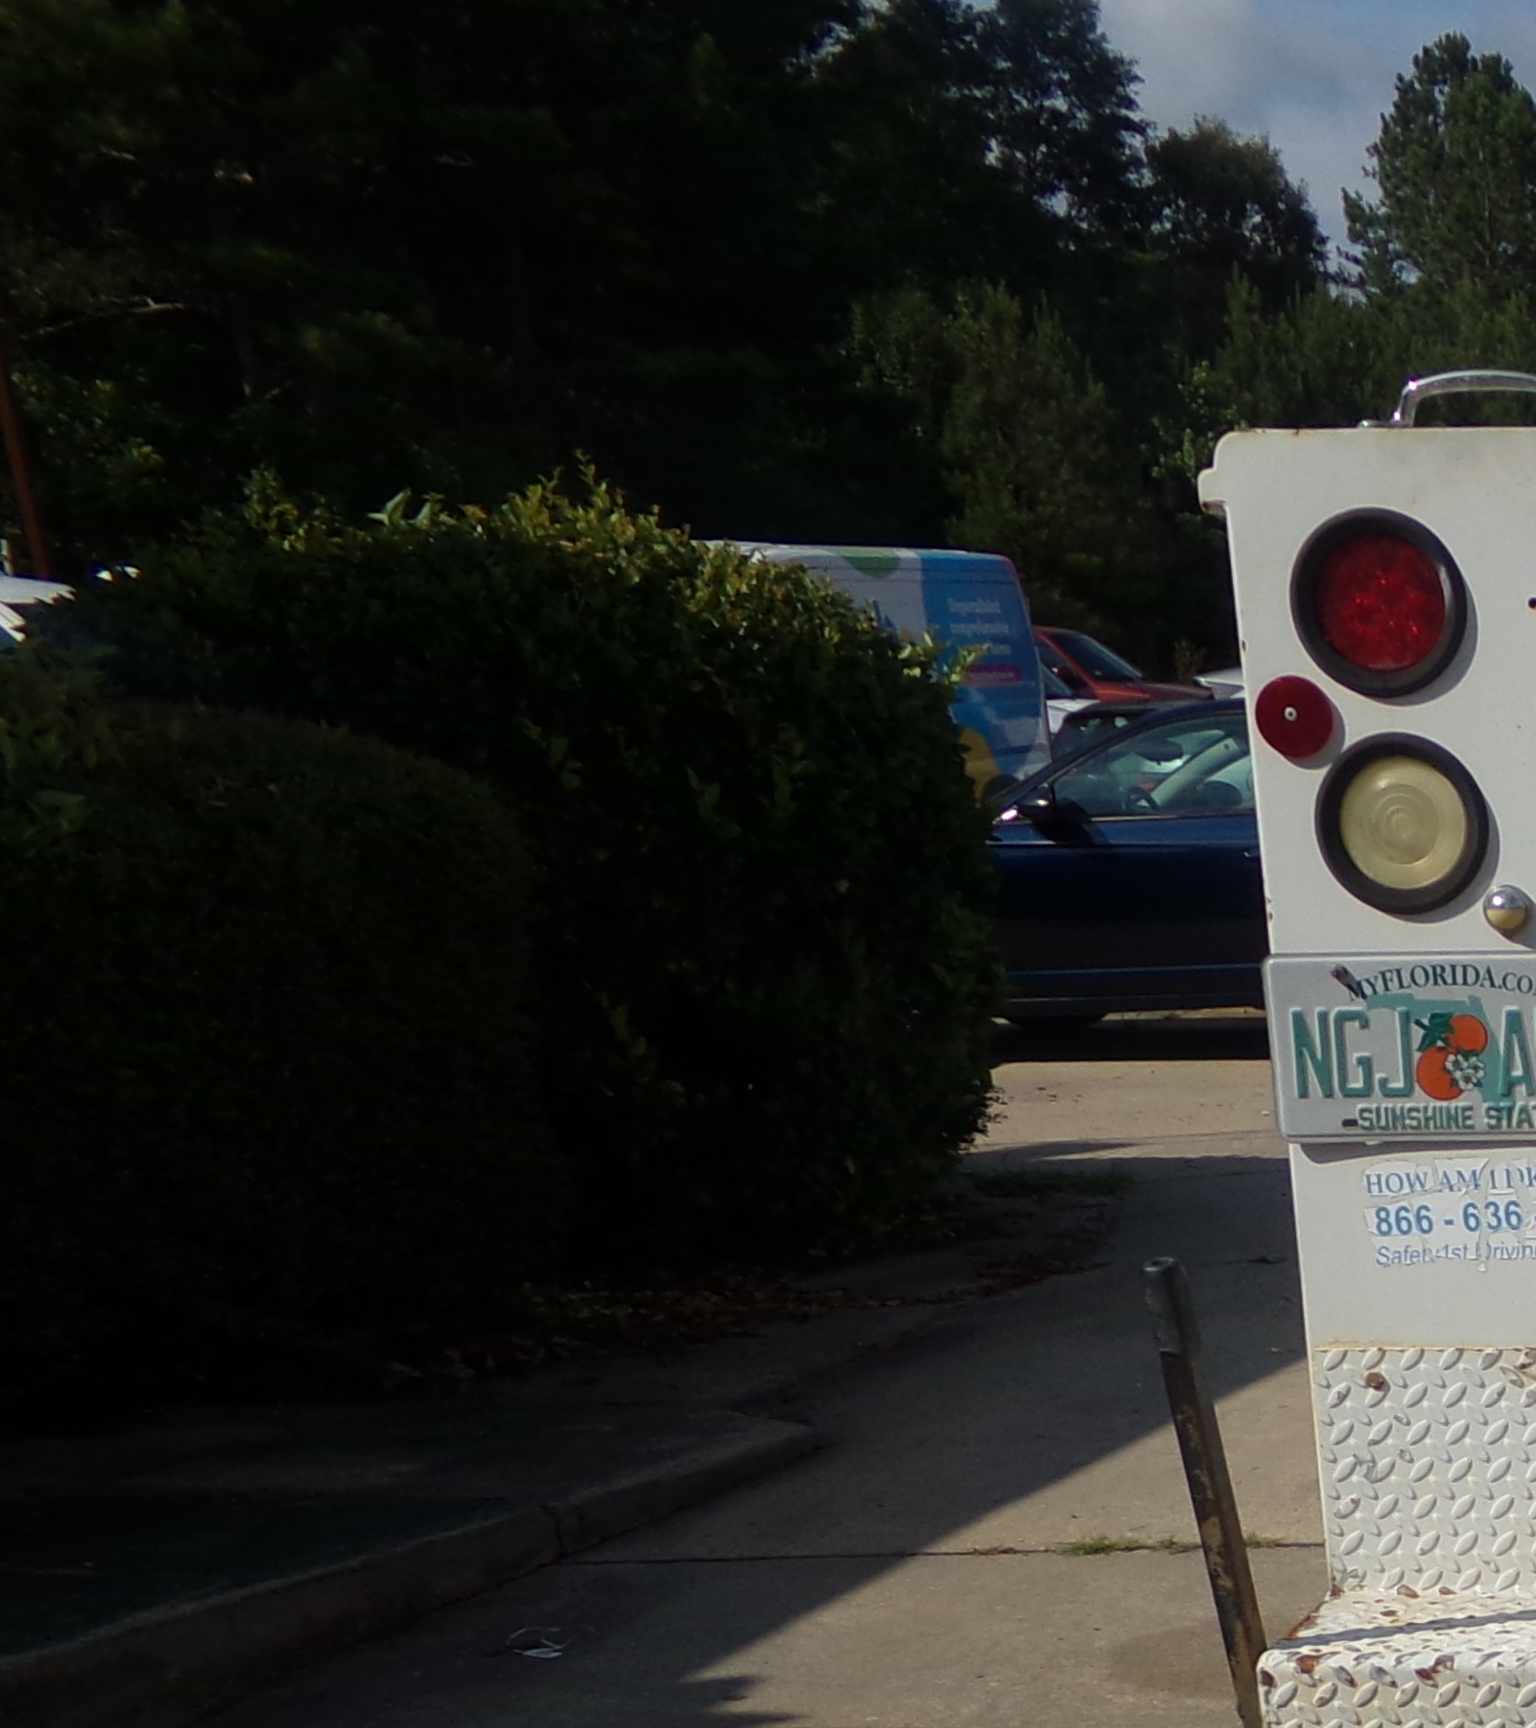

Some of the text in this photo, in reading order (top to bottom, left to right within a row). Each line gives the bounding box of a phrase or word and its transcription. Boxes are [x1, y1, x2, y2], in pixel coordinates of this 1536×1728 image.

[1290, 1005, 1415, 1099] NGJ
[1356, 1102, 1475, 1131] SUNSHINE
[1365, 1171, 1428, 1194] HOW
[1439, 1168, 1482, 1193] AM
